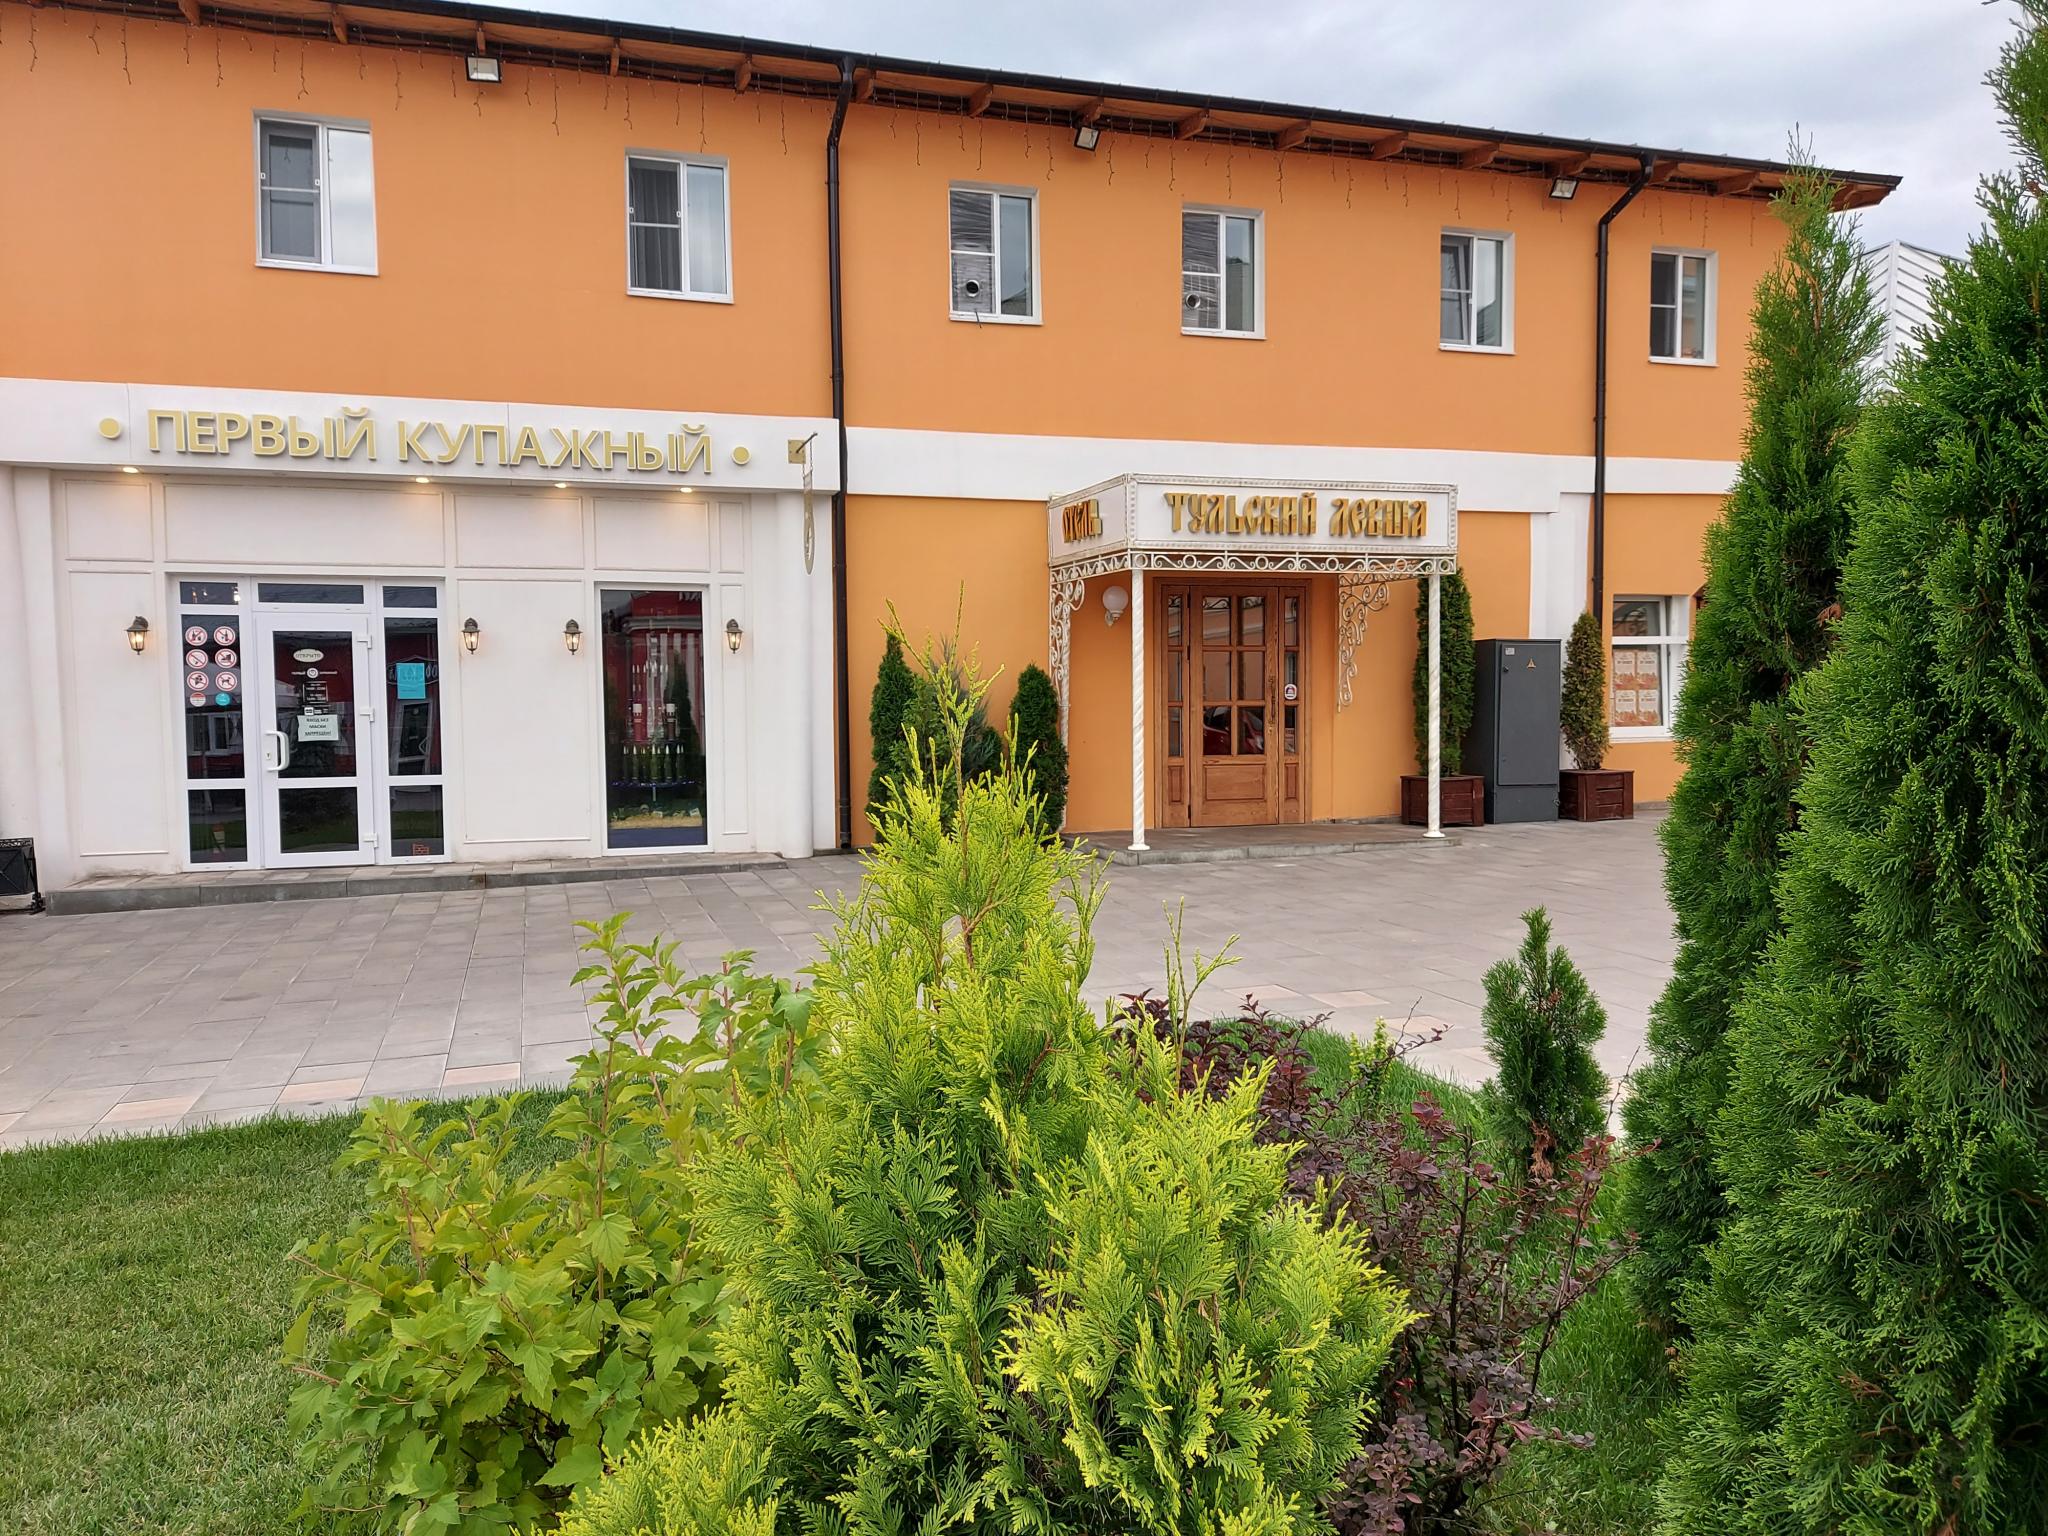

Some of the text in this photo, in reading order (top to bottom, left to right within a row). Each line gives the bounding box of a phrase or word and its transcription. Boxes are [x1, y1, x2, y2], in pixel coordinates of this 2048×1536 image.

[148, 407, 713, 475] ПЕРВЫЙ КУПАЖНЫЙ
[1164, 492, 1427, 537] ТУЛЬСКИЙ ЛЕВША
